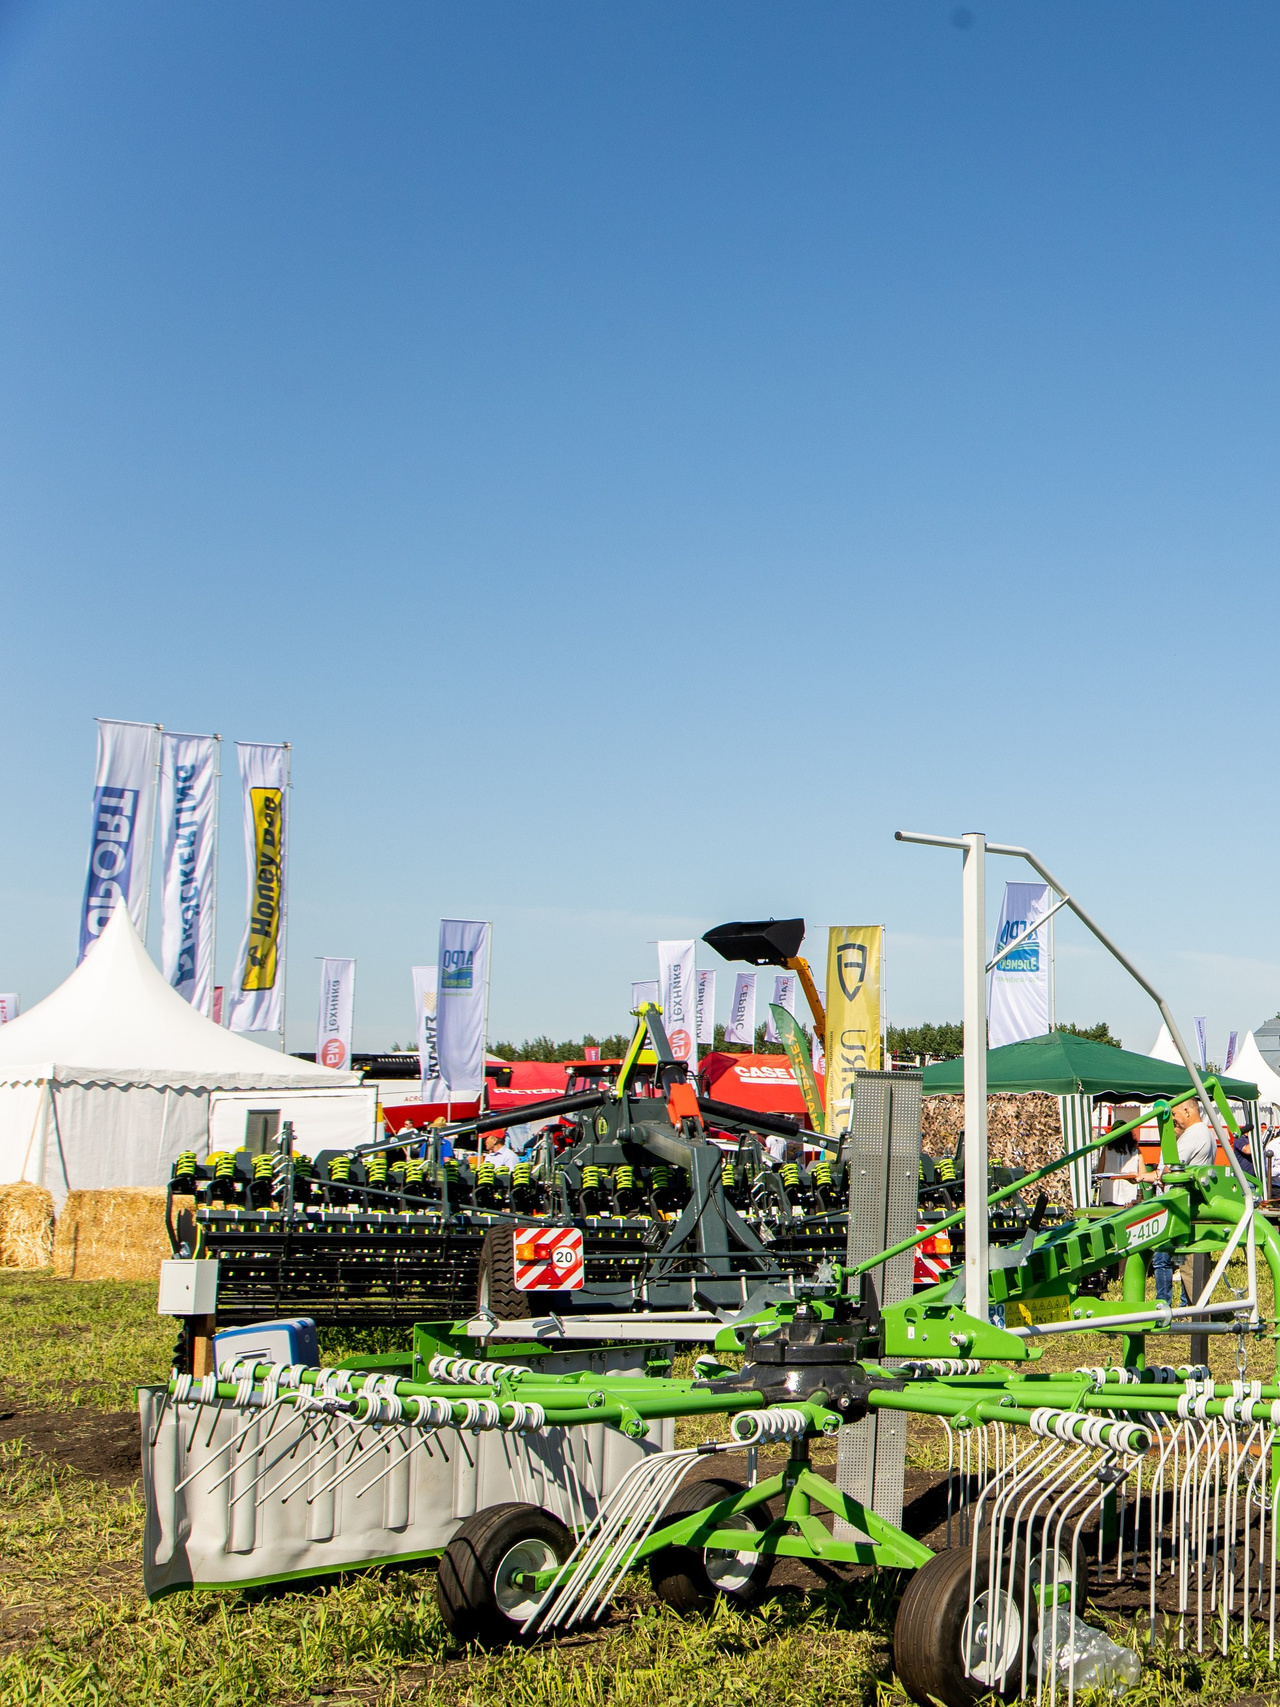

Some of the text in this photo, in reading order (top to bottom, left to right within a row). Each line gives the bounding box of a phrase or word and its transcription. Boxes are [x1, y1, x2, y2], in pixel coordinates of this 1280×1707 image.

[250, 852, 282, 938] Honey
[733, 1066, 790, 1079] CASE
[556, 1251, 573, 1263] 20
